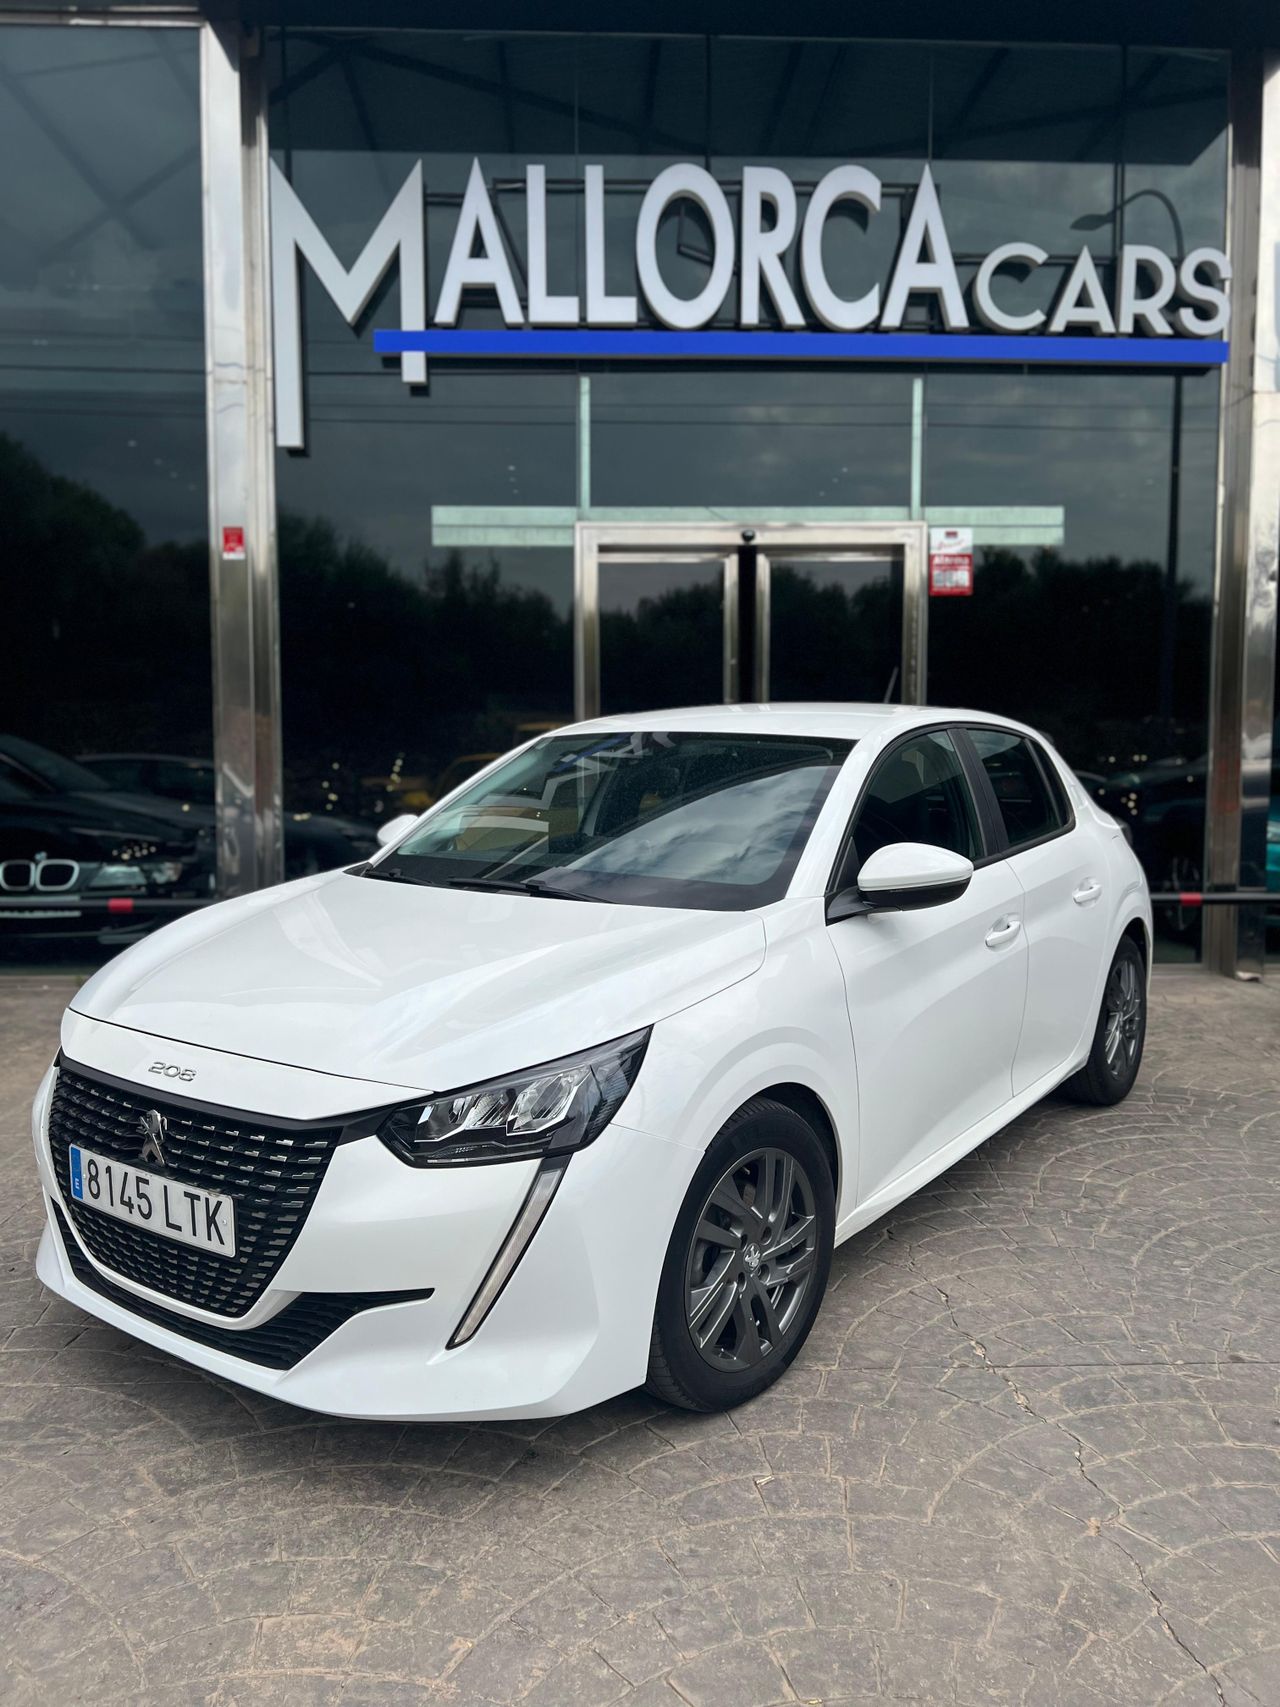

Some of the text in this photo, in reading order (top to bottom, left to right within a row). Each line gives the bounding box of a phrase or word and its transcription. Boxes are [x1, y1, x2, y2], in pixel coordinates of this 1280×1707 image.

[269, 156, 1232, 448] MALLORCA CARS
[148, 1061, 197, 1082] 208
[87, 1158, 225, 1246] 8145 LTK
